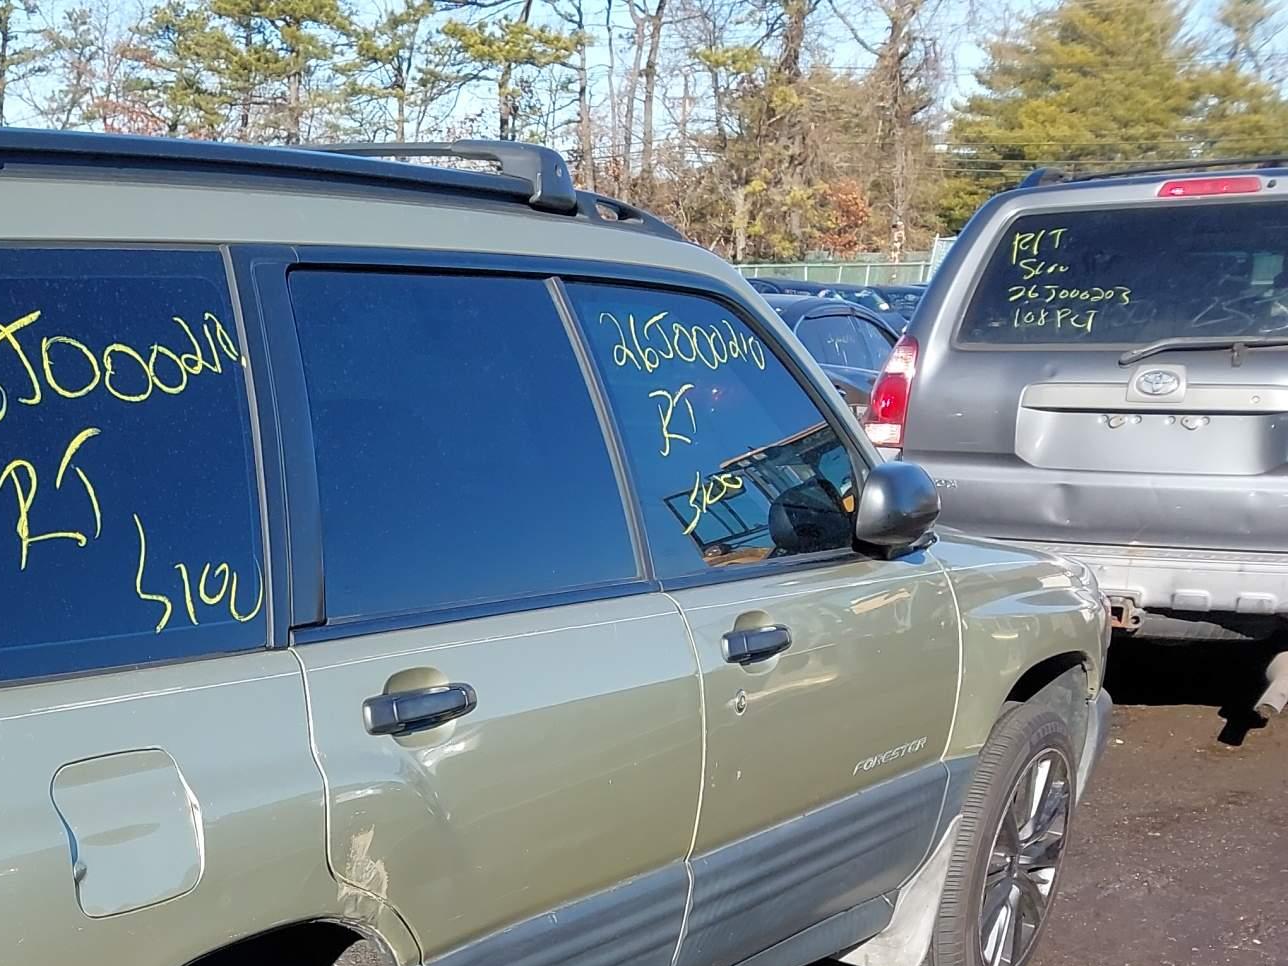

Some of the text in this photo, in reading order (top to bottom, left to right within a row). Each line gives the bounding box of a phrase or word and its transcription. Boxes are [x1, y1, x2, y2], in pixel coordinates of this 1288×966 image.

[1008, 284, 1132, 305] 26J000203
[599, 311, 765, 372] 26J000210
[648, 383, 697, 457] RT
[852, 736, 928, 776] FORESTER
